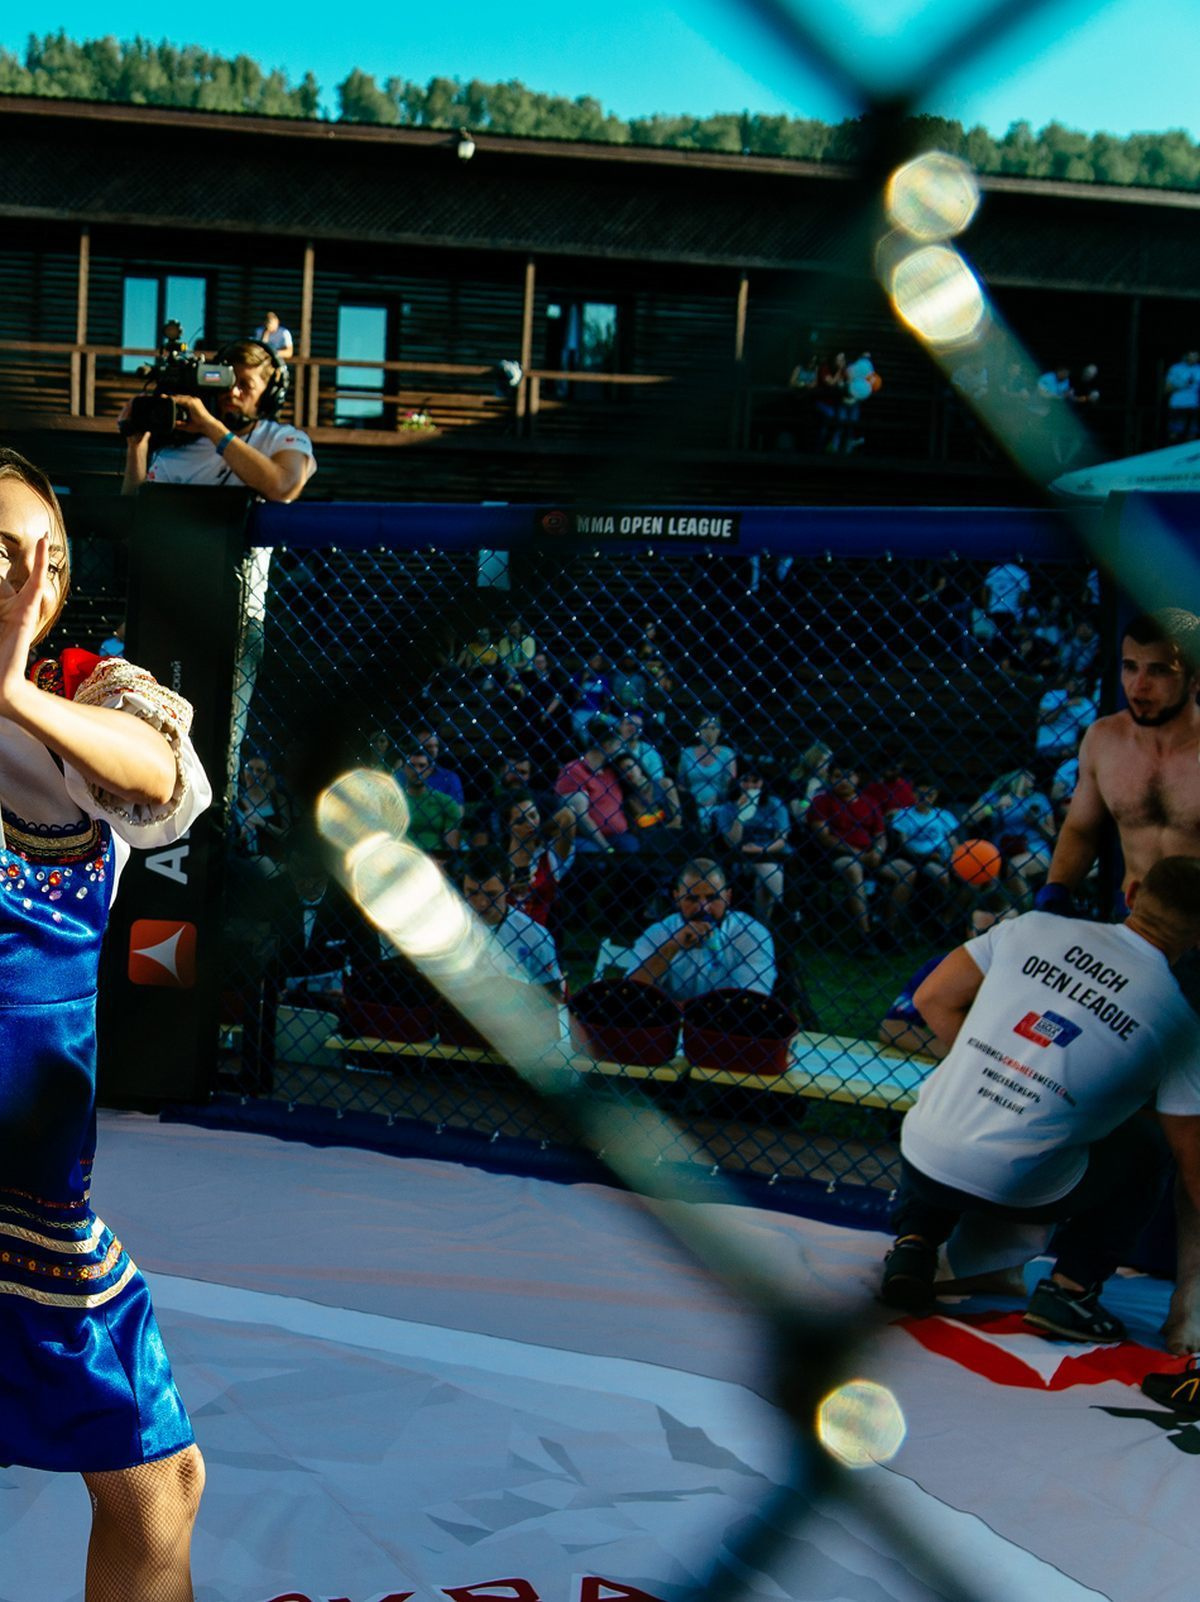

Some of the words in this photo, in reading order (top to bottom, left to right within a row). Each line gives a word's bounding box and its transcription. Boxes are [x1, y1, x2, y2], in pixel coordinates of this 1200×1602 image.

[576, 514, 615, 534] MMA
[620, 516, 664, 535] OPEN
[668, 517, 733, 538] LEAGUE
[1064, 945, 1129, 993] COACH
[1022, 955, 1073, 993] OPEN
[1067, 982, 1140, 1042] LEAGUE
